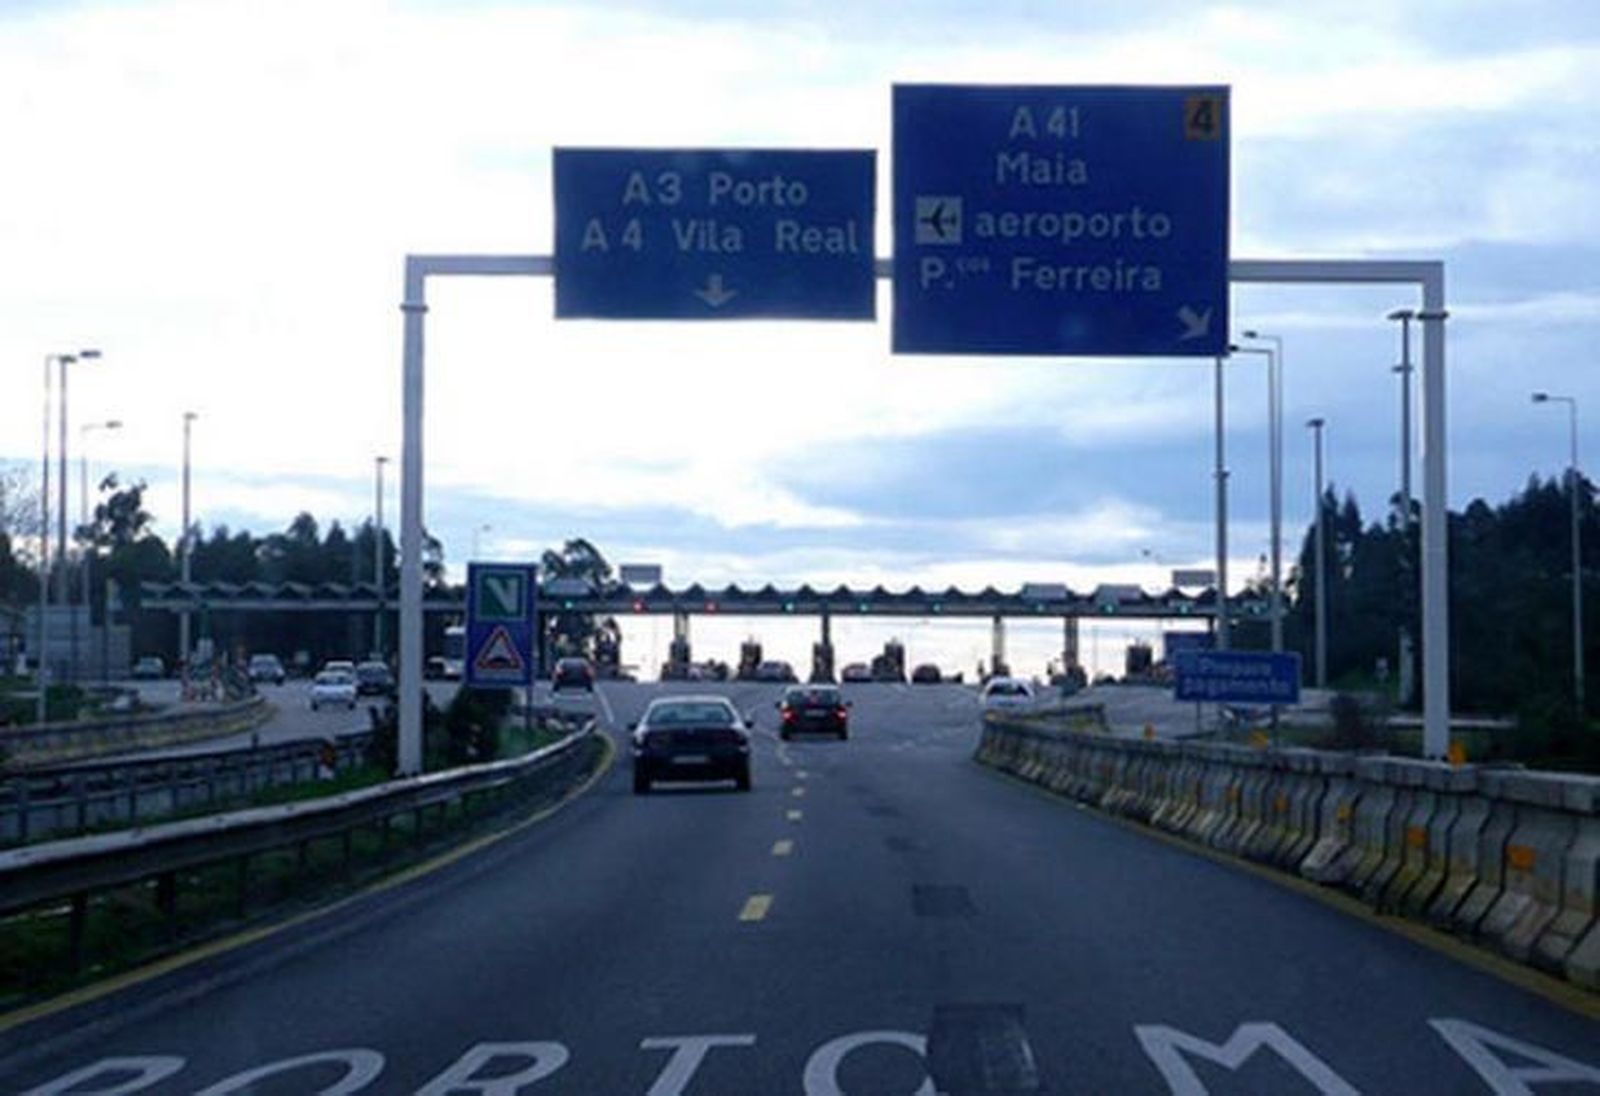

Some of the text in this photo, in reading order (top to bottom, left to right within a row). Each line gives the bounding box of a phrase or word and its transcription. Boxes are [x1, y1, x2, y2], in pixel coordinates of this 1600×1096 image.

[1190, 100, 1214, 133] 4
[996, 152, 1087, 184] Maia
[708, 171, 807, 205] Porto
[672, 219, 742, 252] Vila
[775, 219, 858, 253] Real
[975, 206, 1171, 243] aeroporto
[1011, 256, 1161, 290] Ferreira
